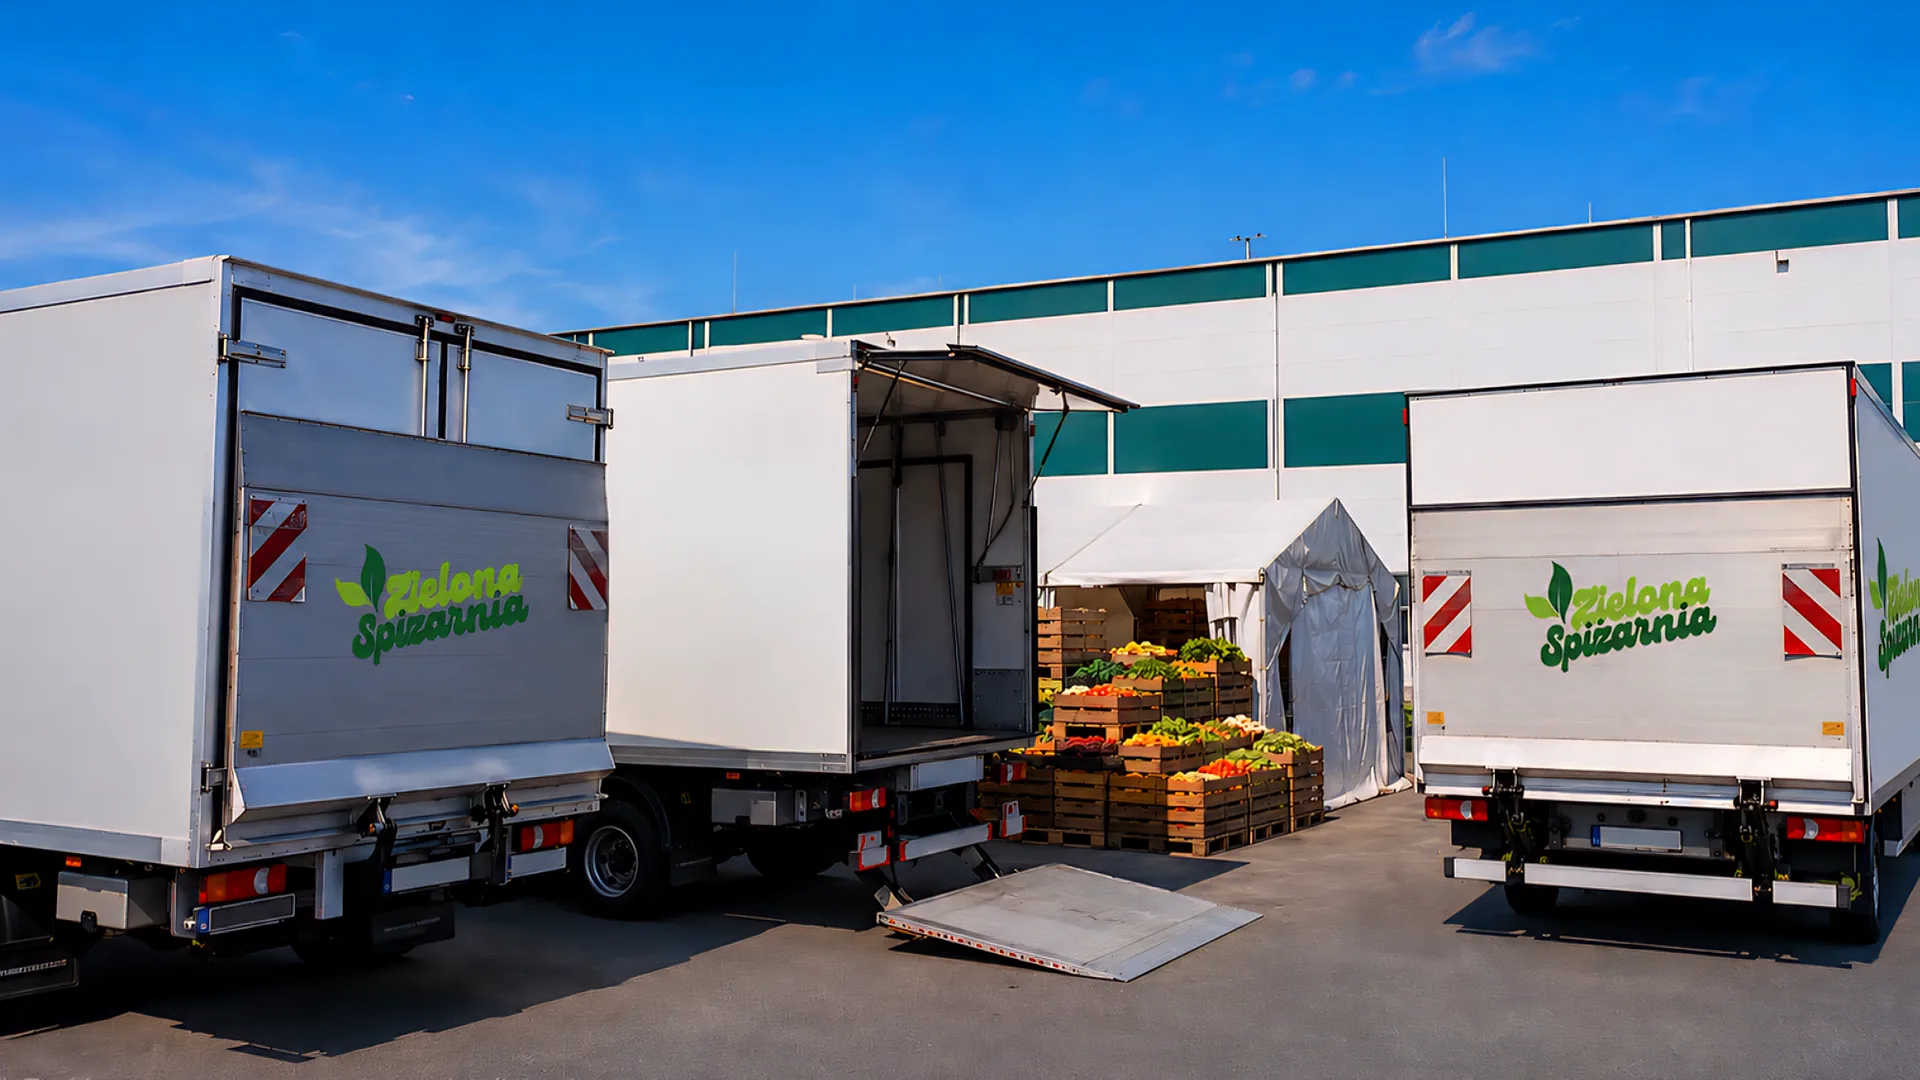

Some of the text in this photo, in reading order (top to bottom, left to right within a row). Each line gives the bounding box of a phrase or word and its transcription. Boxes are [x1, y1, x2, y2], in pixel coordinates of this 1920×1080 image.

[384, 561, 523, 620] Zielona
[1571, 576, 1711, 631] Zielona
[1887, 568, 1920, 626] Zielon
[1541, 602, 1717, 673] Spiżarnia
